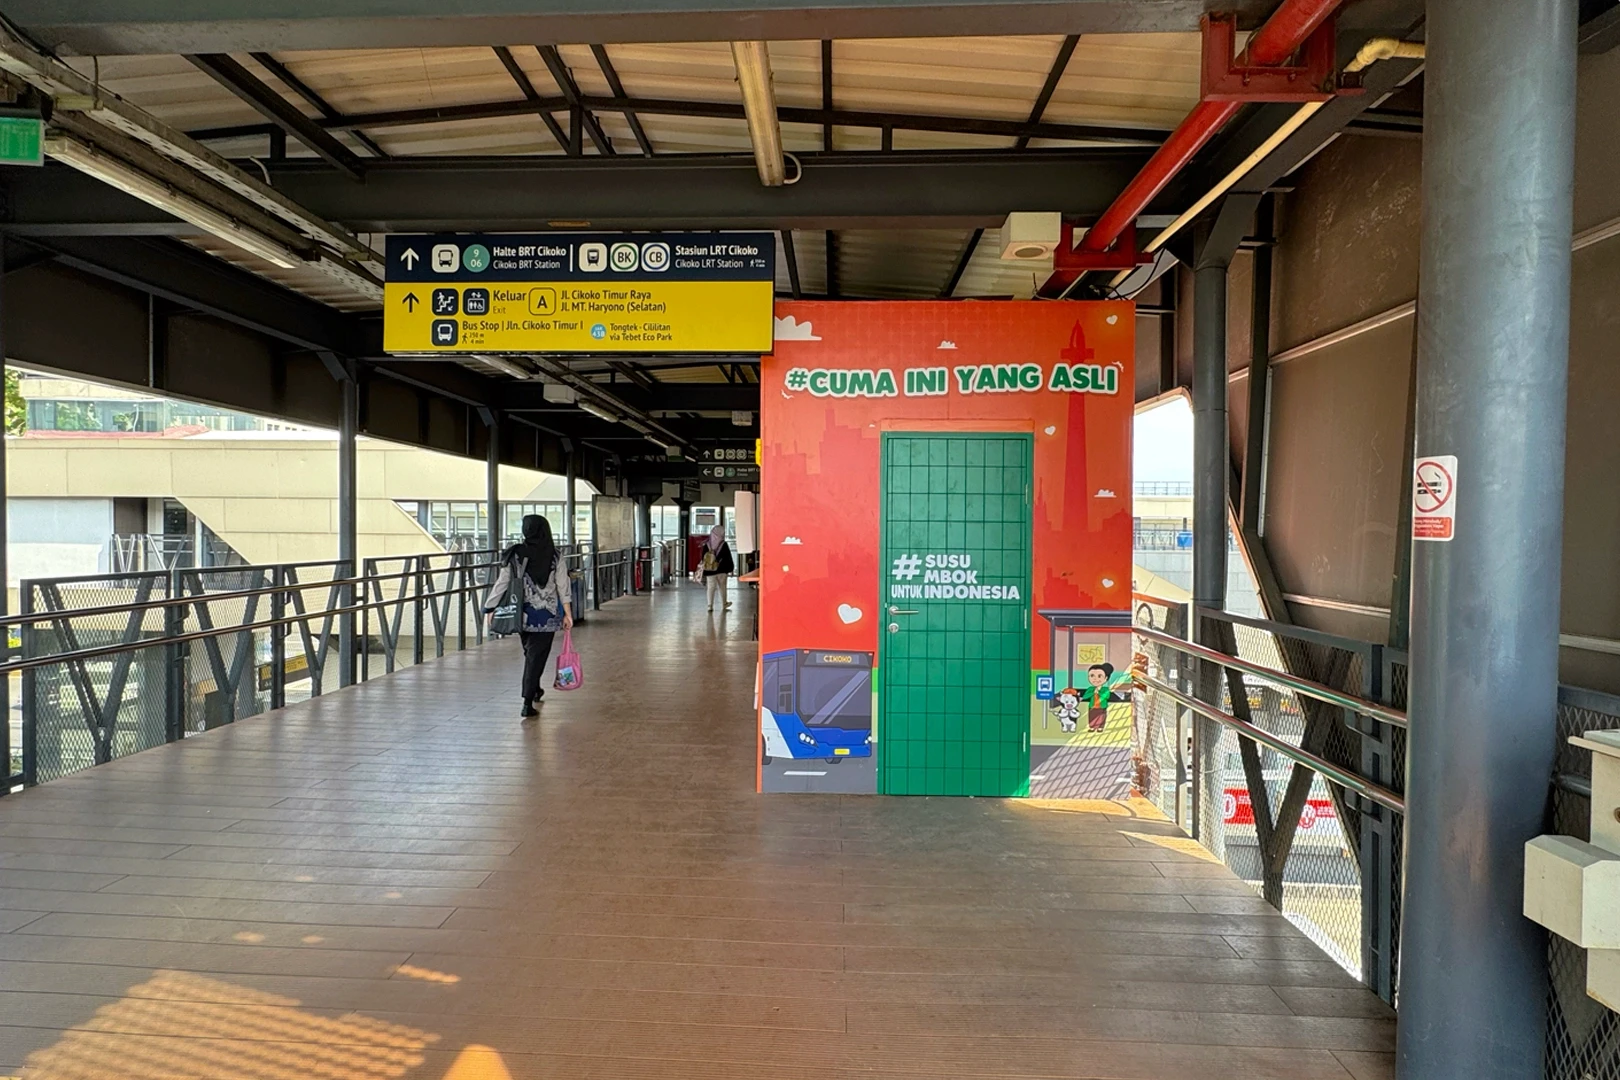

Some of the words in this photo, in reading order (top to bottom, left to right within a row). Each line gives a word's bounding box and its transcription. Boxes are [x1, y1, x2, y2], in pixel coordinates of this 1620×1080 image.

[473, 249, 480, 257] 9
[493, 246, 517, 257] Halte
[518, 246, 536, 257] BRT
[537, 246, 567, 257] Cikoko
[675, 245, 708, 256] Stasiun
[710, 245, 727, 256] LRT
[728, 245, 759, 256] Cikoko
[617, 252, 632, 263] BK
[649, 251, 663, 263] CB
[470, 259, 482, 268] 06
[493, 260, 518, 270] Cikoko
[519, 260, 533, 269] BRT
[534, 260, 561, 270] Station
[675, 259, 700, 268] Cikoko
[702, 259, 716, 268] LRT
[717, 259, 744, 268] Station
[493, 290, 527, 301] Keluar
[571, 290, 601, 300] Cikoko
[602, 290, 628, 300] Timur
[630, 290, 651, 302] Raya
[536, 295, 548, 309] A
[571, 302, 587, 312] MT.
[588, 302, 625, 314] Haryono
[627, 301, 666, 314] (Selatan)
[493, 306, 507, 315] Exit
[462, 321, 478, 331] Bus
[480, 320, 500, 332] Stop
[505, 320, 520, 331] Jln.
[522, 320, 551, 331] Cikoko
[552, 320, 578, 331] Timur
[610, 323, 638, 333] Tongtek
[643, 323, 671, 332] Cililitan
[610, 333, 620, 341] via
[621, 333, 641, 341] Tebet
[643, 333, 655, 341] Eco
[656, 333, 673, 341] Park
[787, 369, 897, 396] #CUMA
[906, 369, 947, 395] INI
[956, 365, 1041, 393] YANG
[1050, 364, 1117, 393] ASLI
[925, 554, 971, 569] SUSU
[924, 570, 978, 584] MBOK
[891, 584, 922, 599] UNTUK
[924, 584, 1020, 600] INDONESIA
